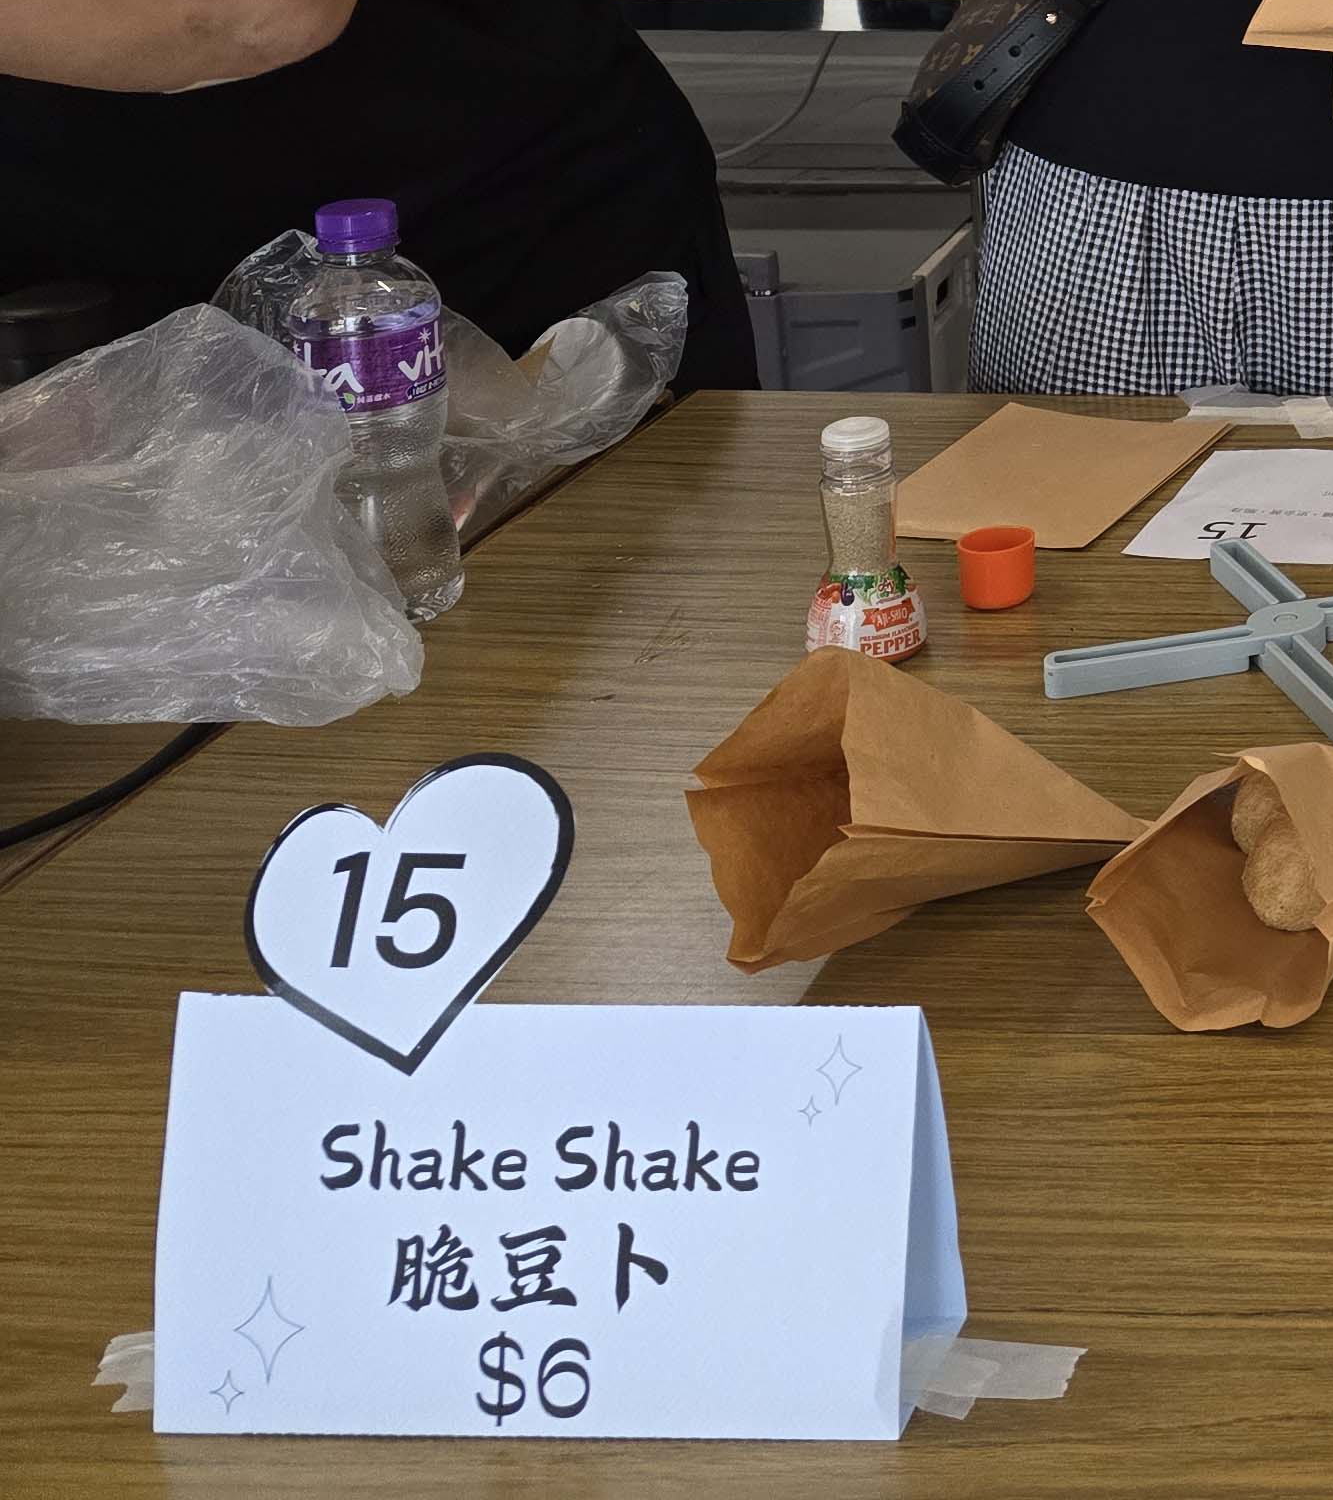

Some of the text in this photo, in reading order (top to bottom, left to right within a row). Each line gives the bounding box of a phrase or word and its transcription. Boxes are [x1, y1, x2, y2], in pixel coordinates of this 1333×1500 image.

[1196, 521, 1268, 541] 15
[860, 628, 922, 656] PEPPER
[328, 850, 467, 970] 15
[319, 1119, 761, 1194] Shake Shake
[387, 1222, 669, 1314] 脆豆卜
[475, 1331, 592, 1428] $6
